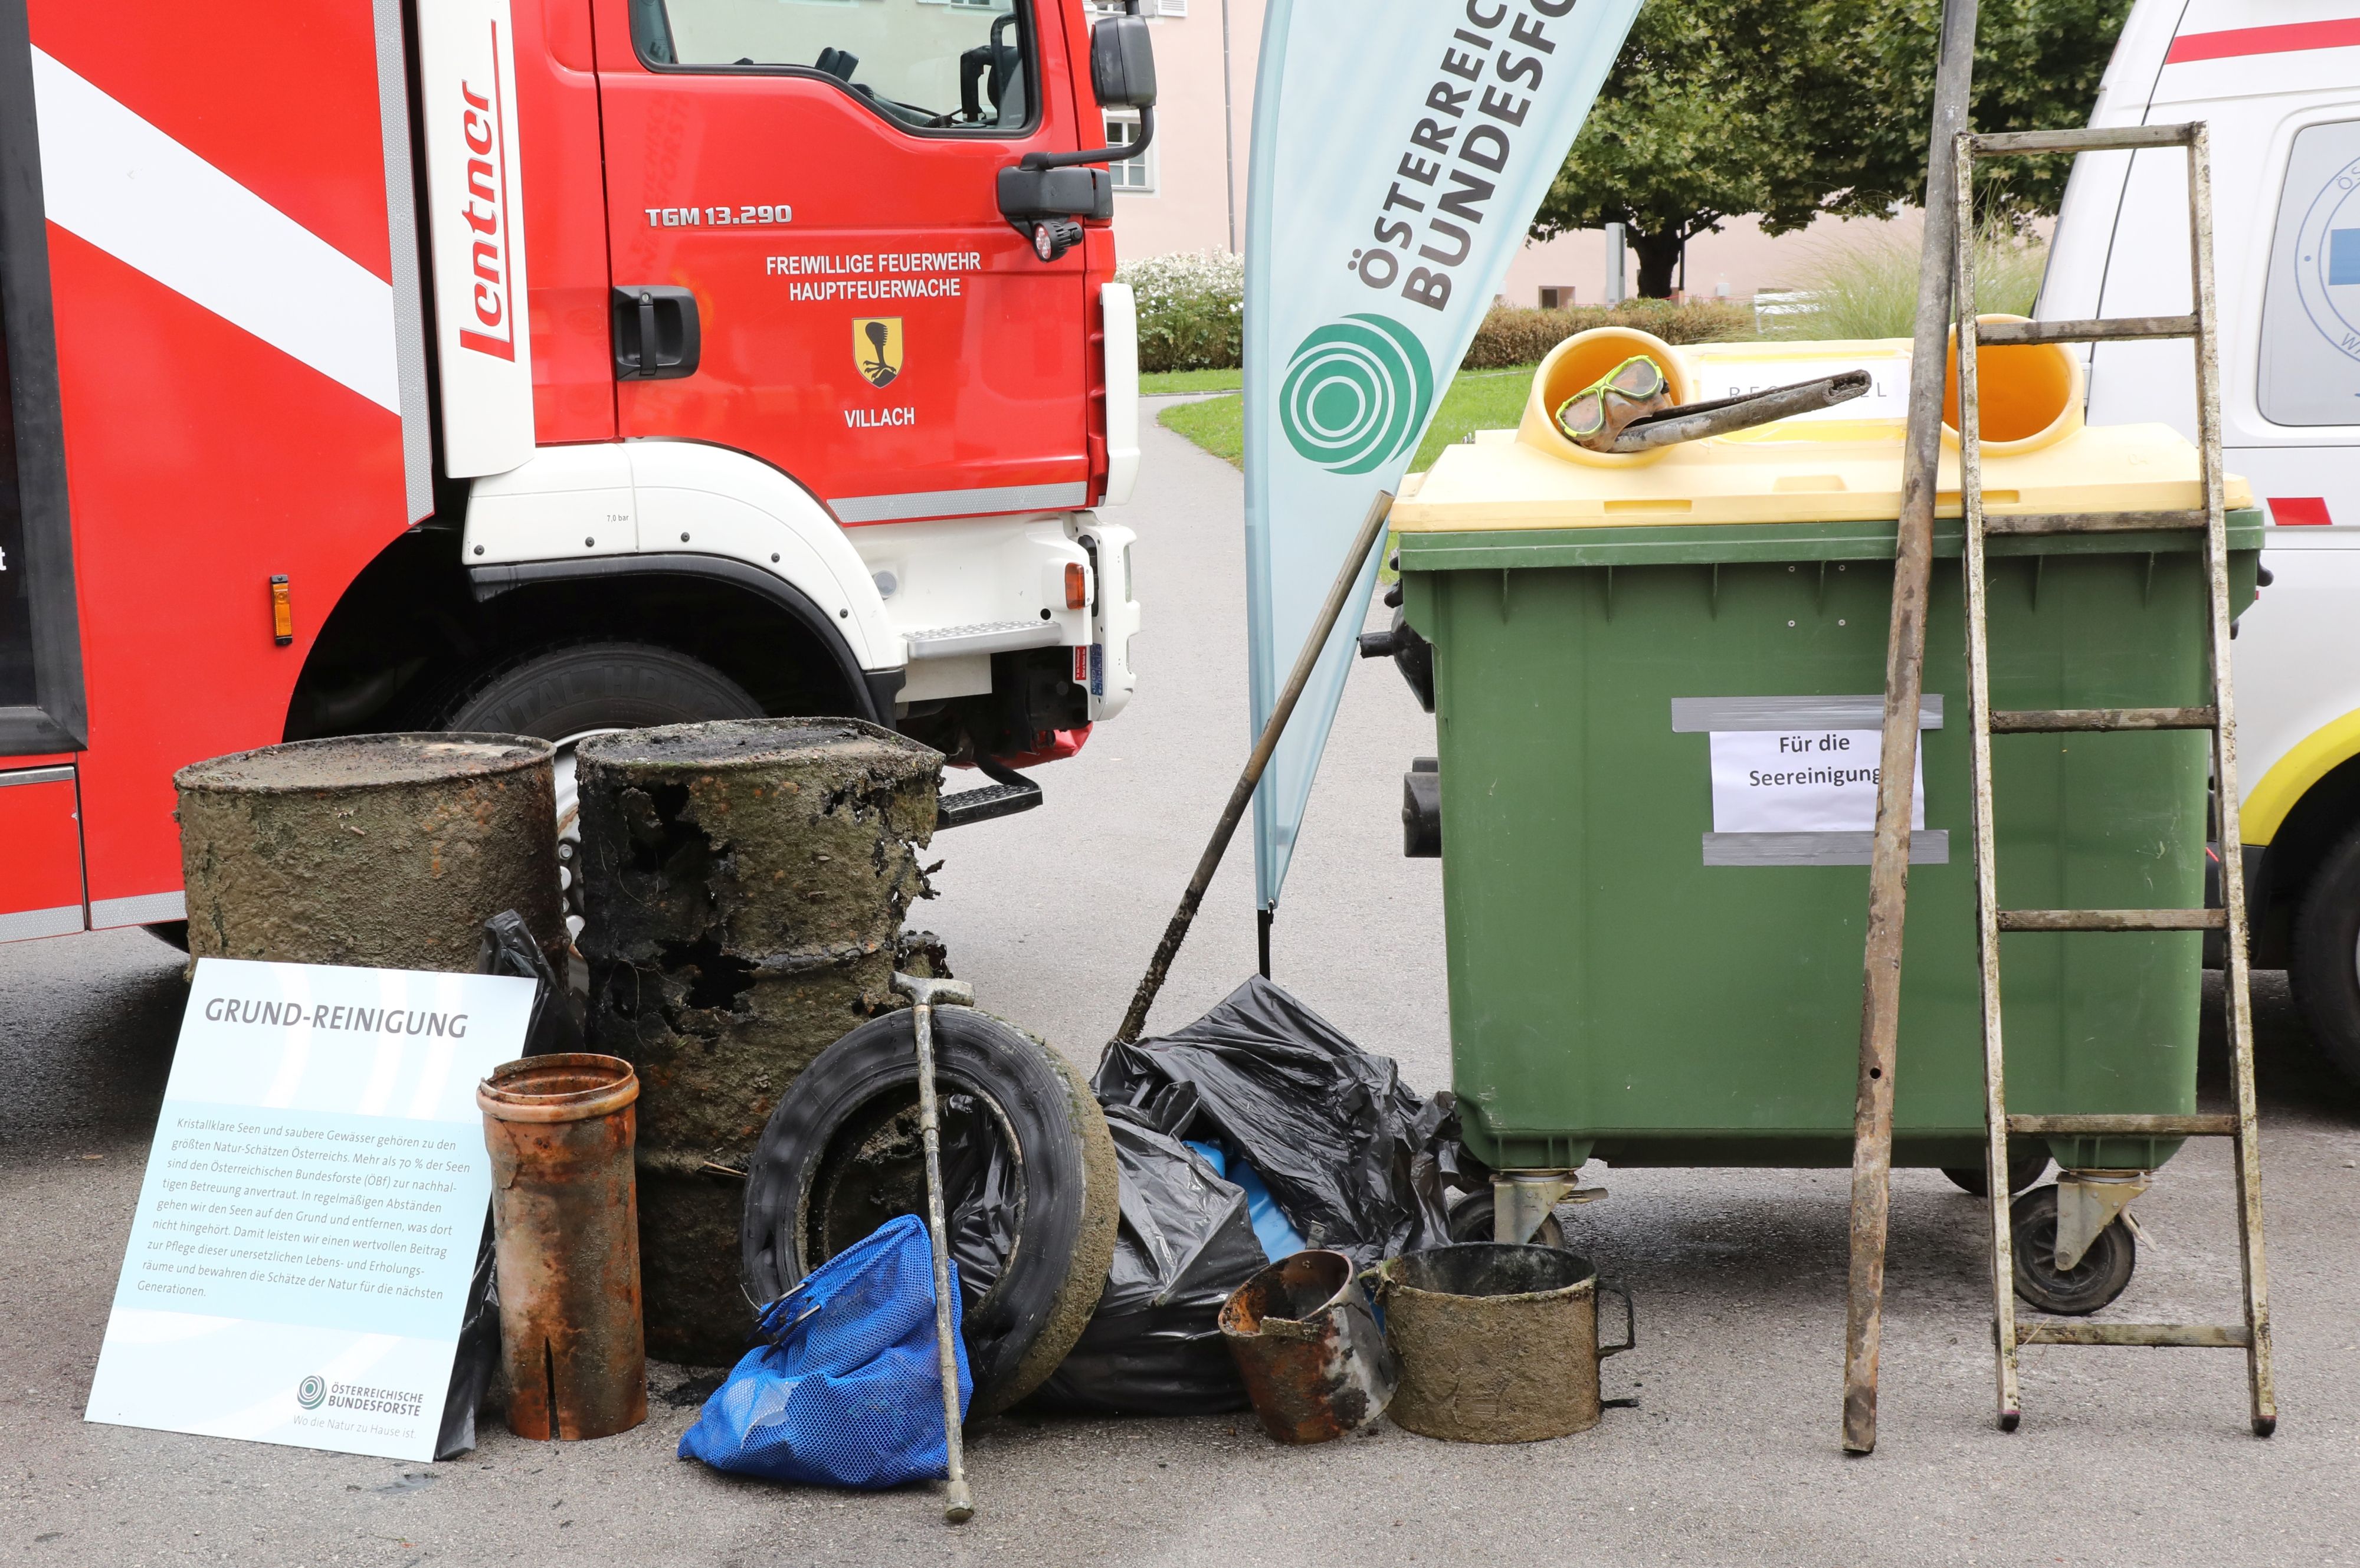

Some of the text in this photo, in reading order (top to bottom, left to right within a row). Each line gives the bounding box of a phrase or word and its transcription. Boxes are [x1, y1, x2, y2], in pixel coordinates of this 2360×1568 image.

[645, 204, 793, 227] TGM 13.290
[766, 251, 981, 275] FREIWILLIGE FEUERWEHR
[789, 278, 961, 301] HAUPTFEUERWACHE
[844, 406, 915, 428] VILLACH
[1779, 734, 1850, 753] Für die
[205, 998, 469, 1039] GRUND-REINIGUNG
[177, 1118, 456, 1150] Kristallklare Seen und saubere Gewässer gehören zu den
[171, 1138, 470, 1173] größten Natur-Schätzen Österreichs. Mehr als 70 % der Seen
[167, 1158, 457, 1193] sind den Österreichischen Bundesforste (ÖBf) zur nachhal-
[162, 1178, 442, 1213] tigen Betreuung anvertraut. In regelmäßigen Abständen
[156, 1199, 453, 1236] gehen wir den Seen auf den Grund und entfernen, was dort
[152, 1219, 448, 1260] nicht hingehört. Damit leisten wir einen wertvollen Beitrag
[147, 1241, 425, 1278] zur Pflege dieser unersetzlichen Lebens- und Erholungs-
[137, 1280, 206, 1297] Generationen.
[142, 1259, 443, 1300] räume und bewahren die Schätze der Natur für die nächsten
[327, 1395, 421, 1417] BUNDESFORSTE
[331, 1381, 424, 1403] ÖSTERREICHISCHE
[293, 1415, 415, 1439] Wo die Natur zu Hause ist.
